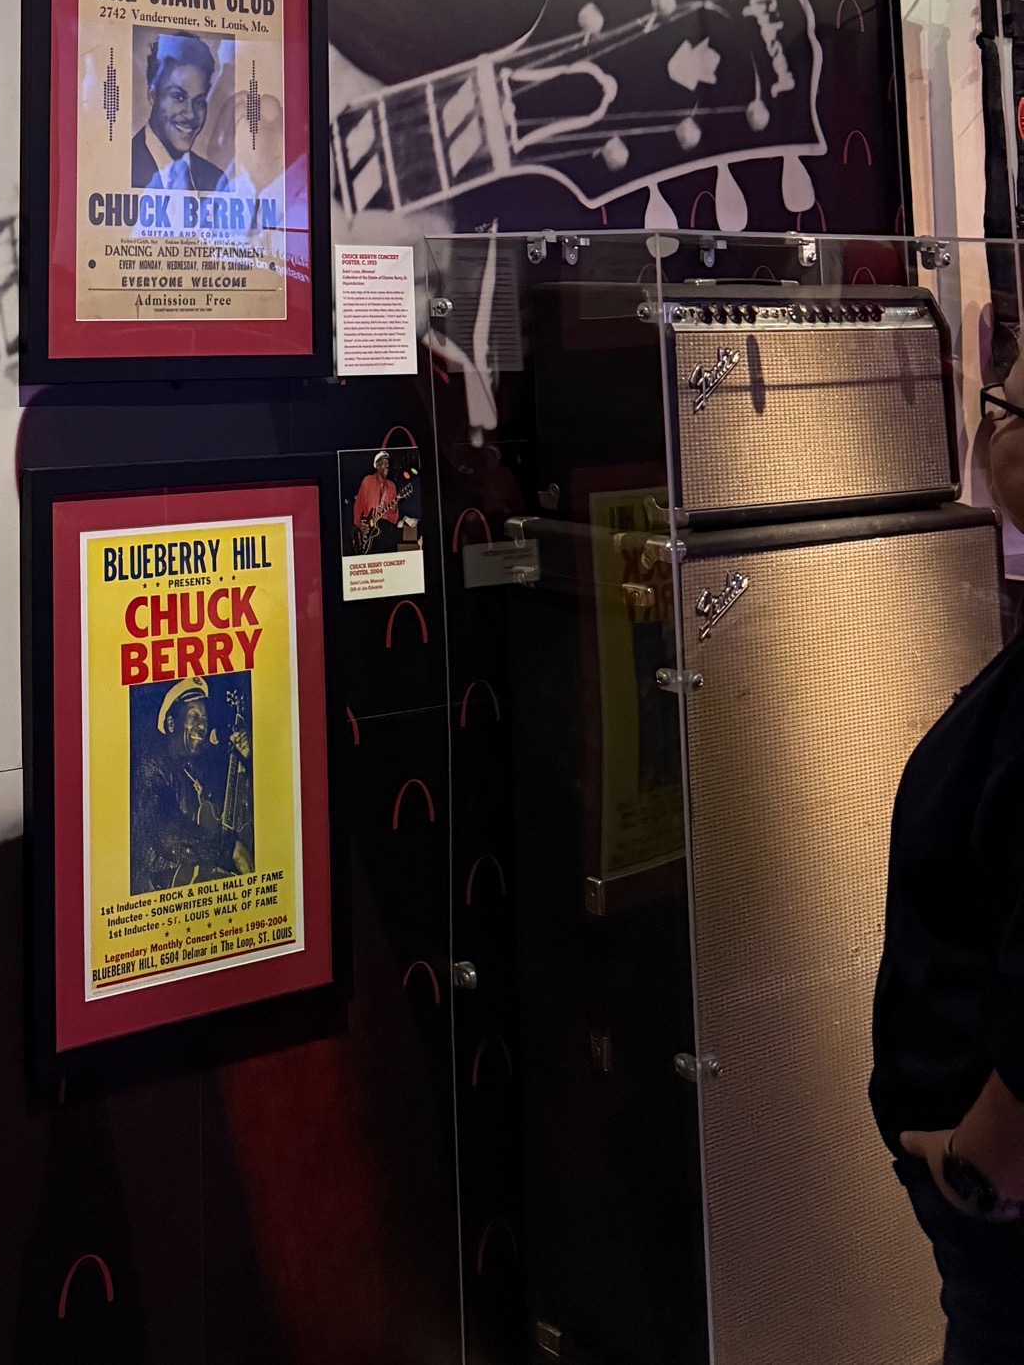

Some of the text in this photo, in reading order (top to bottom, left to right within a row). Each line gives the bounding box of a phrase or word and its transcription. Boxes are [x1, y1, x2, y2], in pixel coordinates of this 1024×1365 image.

[100, 7, 268, 33] 2742 Vanderventer, St. Louis, Mo.
[89, 193, 276, 230] CHUCK BERRYN
[105, 245, 265, 258] DANCING AND ENTERTAINMENT
[119, 260, 135, 270] EVERY
[139, 261, 163, 271] MONDAY,
[167, 261, 198, 271] WEDNESDAY,
[202, 261, 220, 270] FRIDAY
[222, 262, 226, 270] &
[122, 277, 247, 287] EVERYONE WELCOME
[135, 295, 231, 306] Admission Free
[104, 536, 271, 582] BLUEBERRY HILL
[168, 577, 211, 589] PRESENTS
[125, 586, 261, 639] CHUCK
[121, 628, 263, 686] BERRY
[100, 871, 284, 916] 1st Inductee ROCK & ROLL HALL OF FAME
[107, 884, 278, 927] Inductee SONGWRITERS HALL OF FAME
[109, 895, 278, 939] 1st Inductee ST. LOUIS WALK OF FAME
[92, 926, 292, 982] BLUEBERRY HILL, 6504 Delmar in The Loop, ST. LOUIS
[105, 915, 287, 964] Legendary Monthly Concert Series 1996-2004
